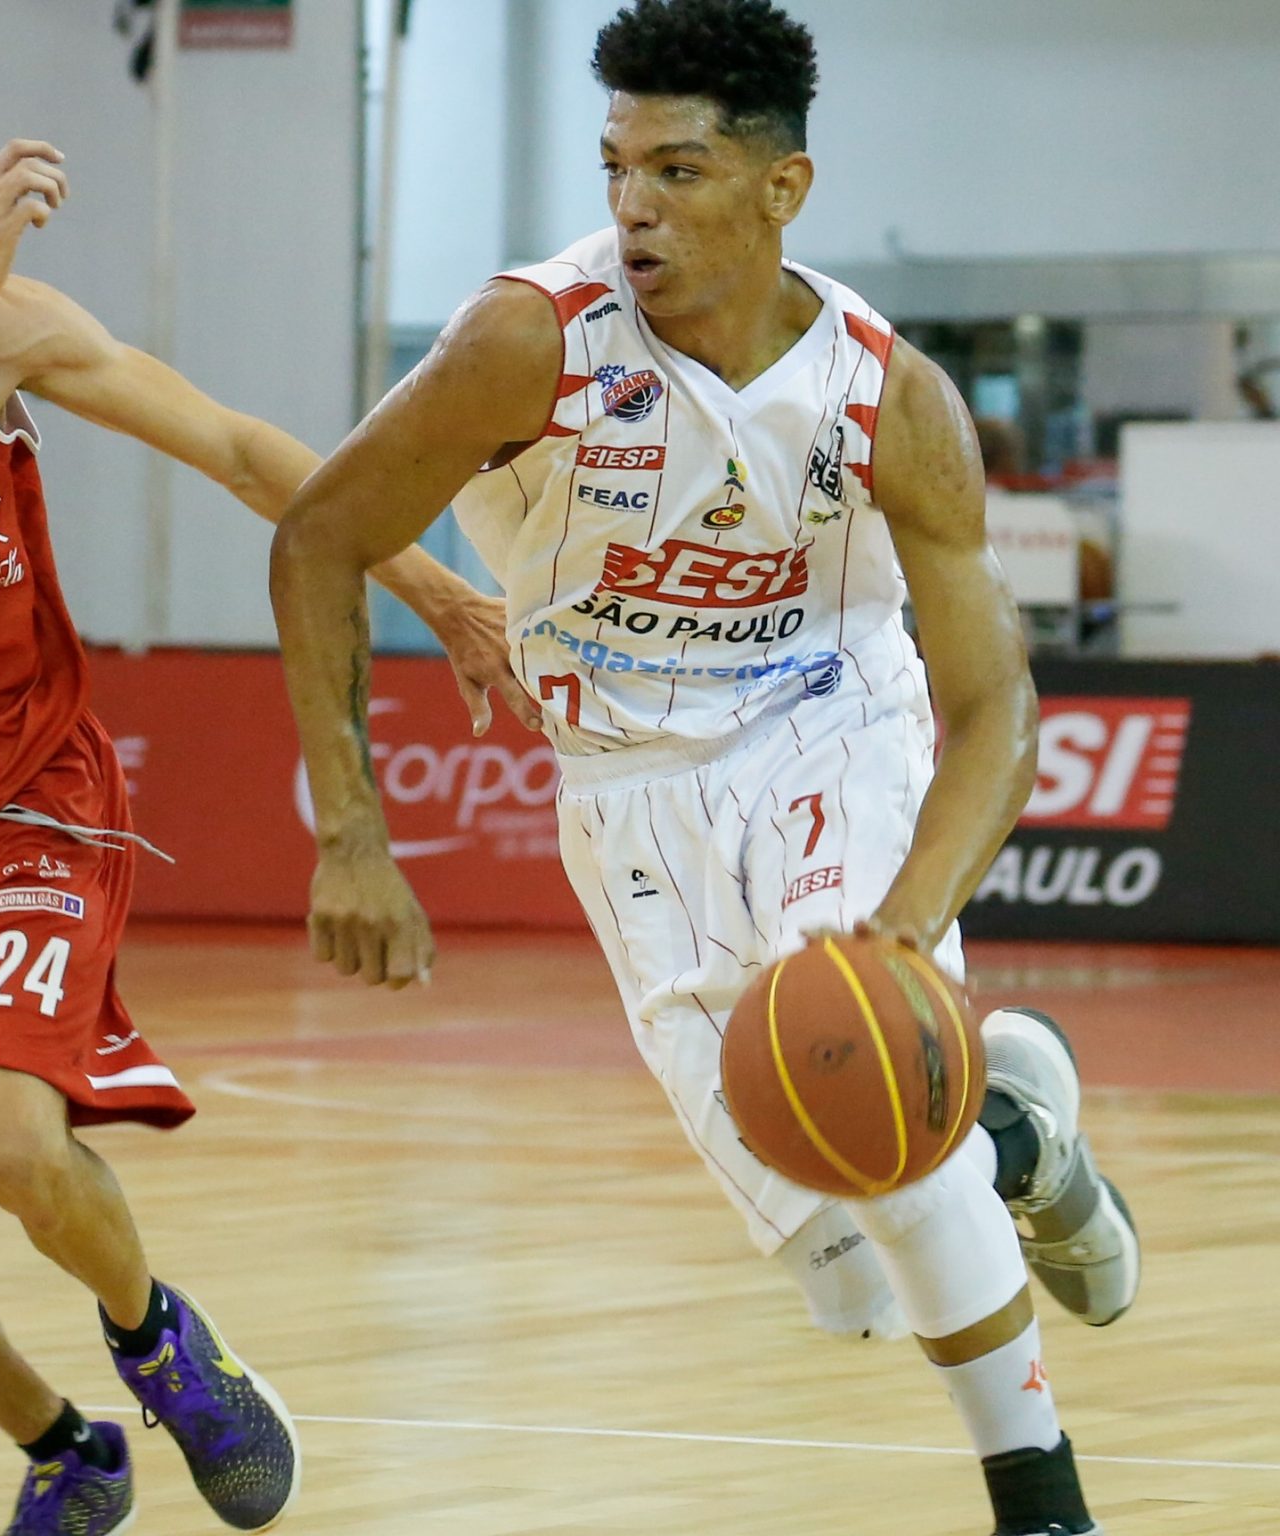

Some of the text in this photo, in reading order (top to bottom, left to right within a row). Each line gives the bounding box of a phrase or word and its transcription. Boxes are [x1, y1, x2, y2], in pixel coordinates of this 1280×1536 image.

[582, 448, 660, 468] FIESP
[578, 483, 650, 510] FEAC
[571, 595, 805, 644] SÃO PAULO
[538, 672, 581, 727] 7
[1022, 710, 1155, 819] SI
[788, 789, 826, 859] 7
[970, 846, 1163, 907] AULO
